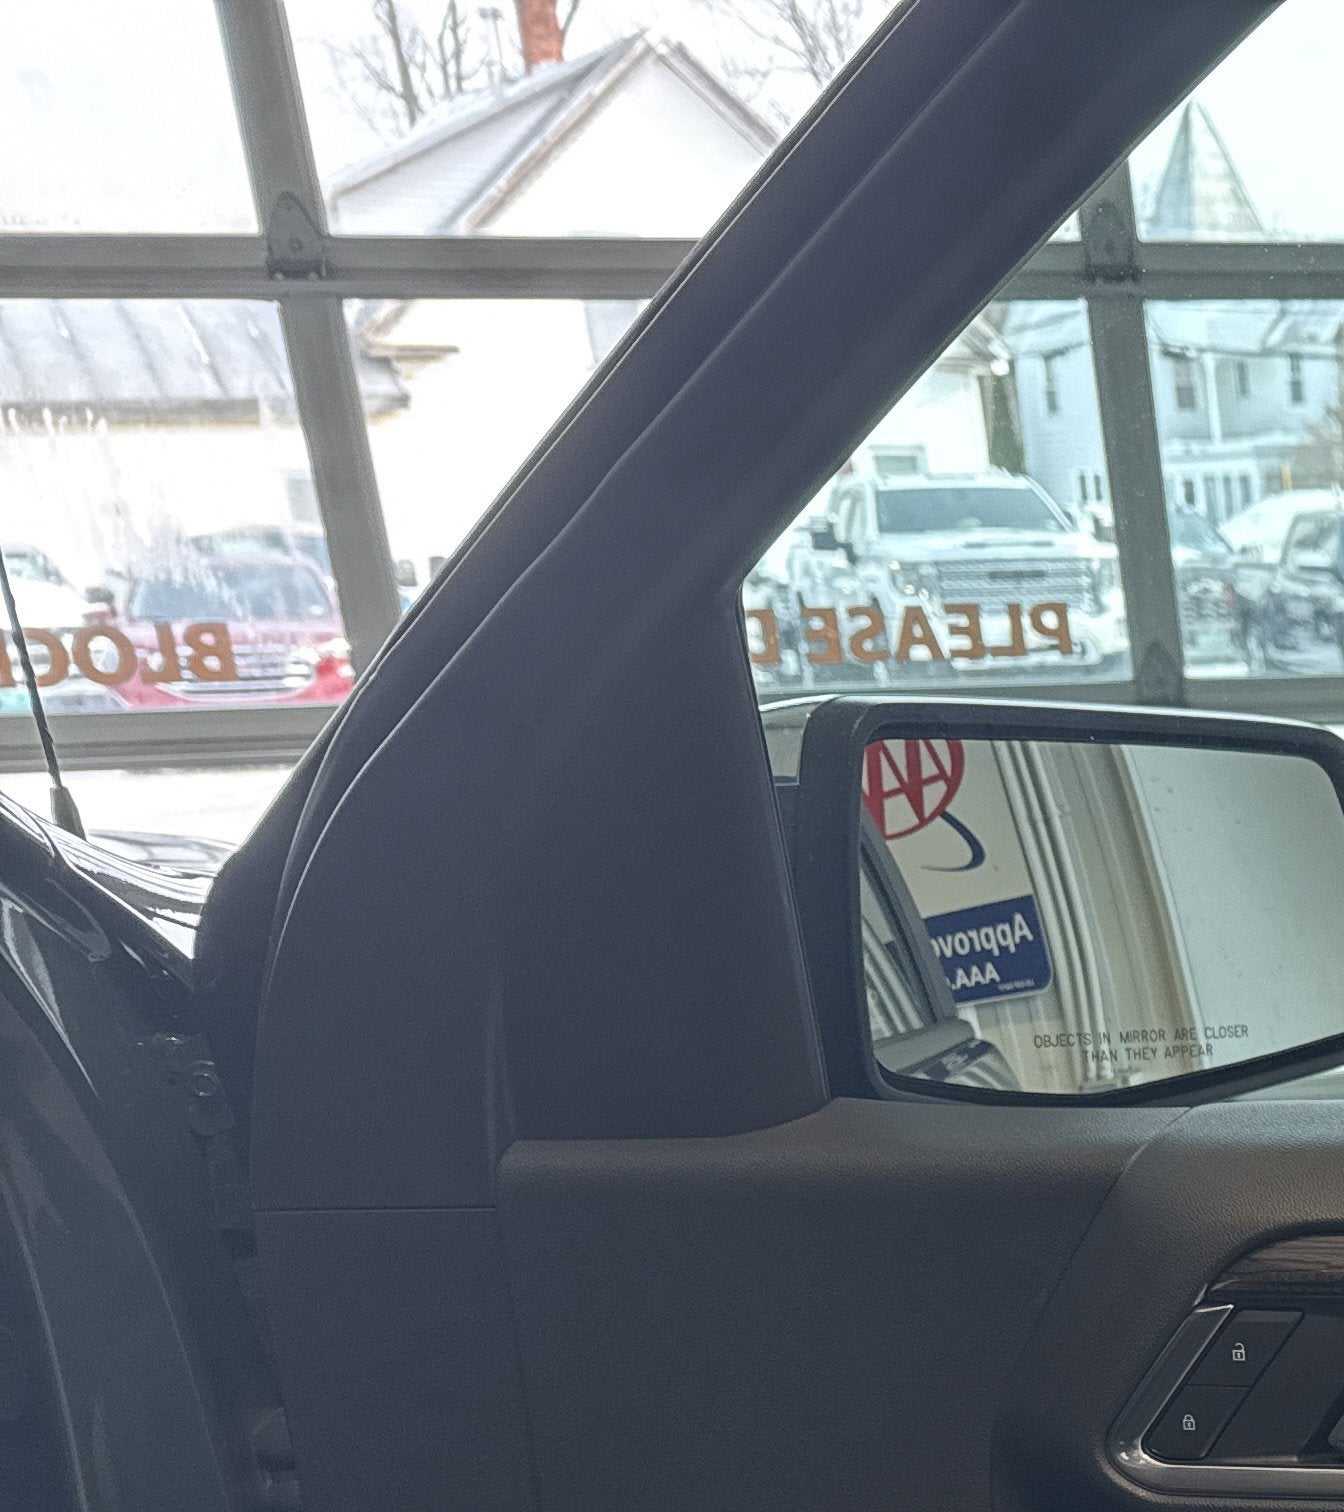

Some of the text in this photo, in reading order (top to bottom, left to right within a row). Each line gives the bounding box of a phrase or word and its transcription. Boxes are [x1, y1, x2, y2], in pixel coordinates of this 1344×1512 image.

[1033, 1024, 1249, 1049] OBJECTS IN MIRROR ARE CLOSER
[1081, 1043, 1214, 1063] THAN THEY APPEAR
